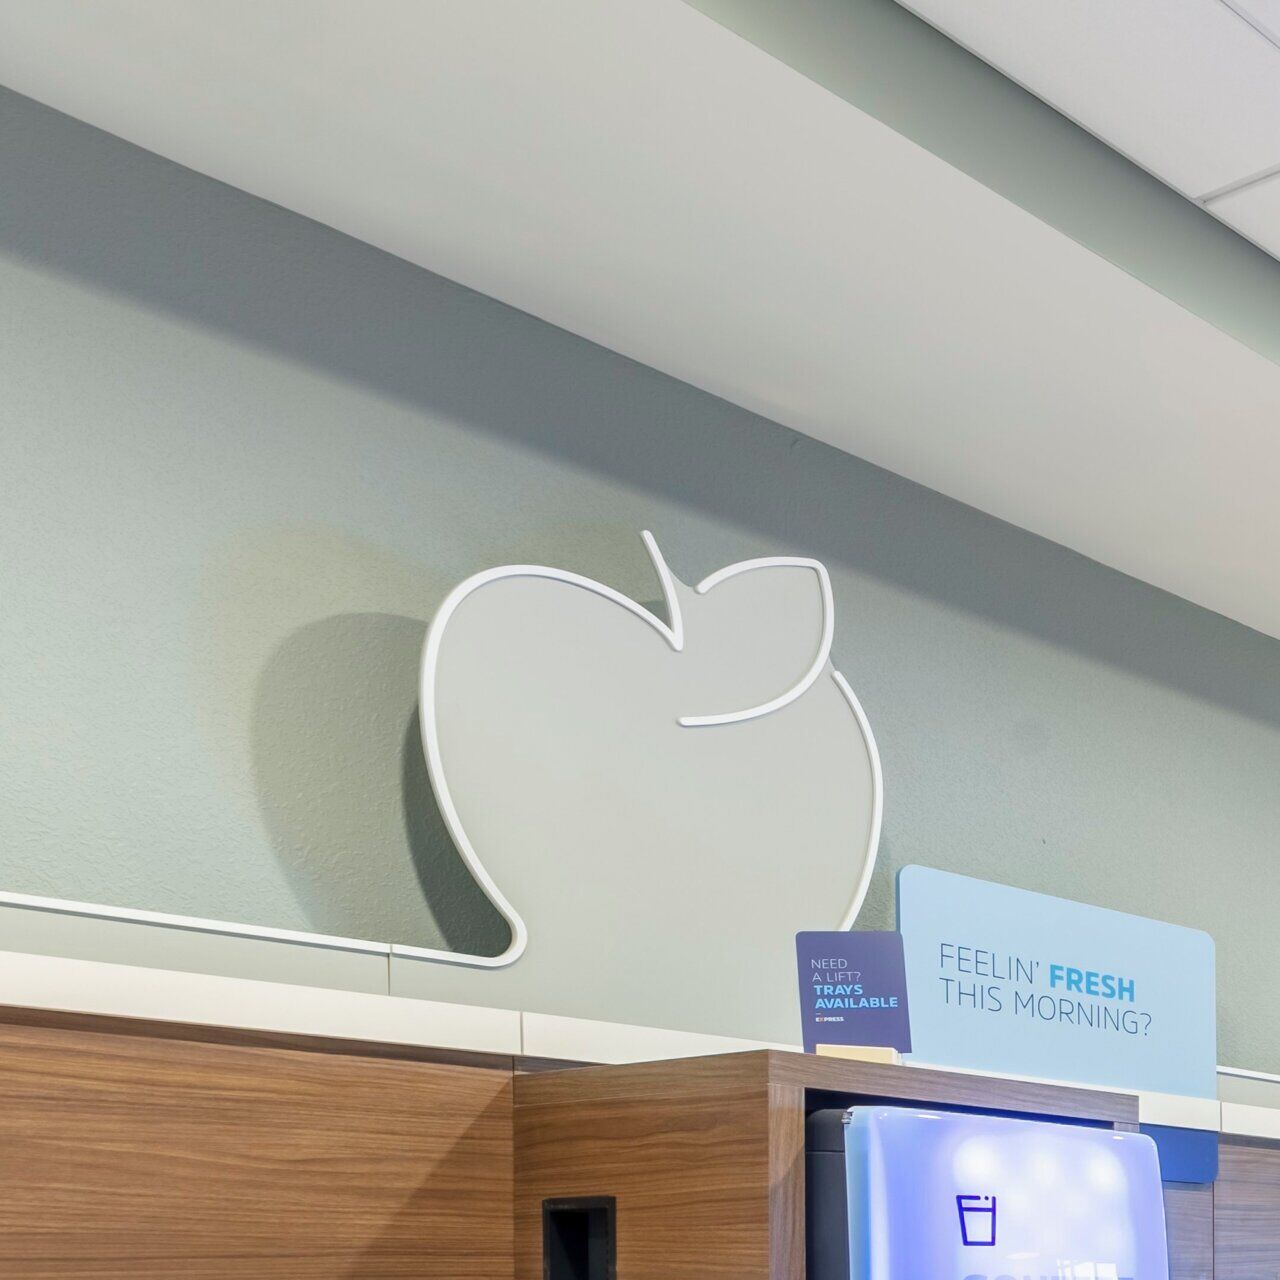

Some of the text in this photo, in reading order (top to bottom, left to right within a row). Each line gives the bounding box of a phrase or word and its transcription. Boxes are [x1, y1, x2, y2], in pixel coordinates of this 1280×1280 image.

[811, 958, 848, 969] NEED
[812, 971, 861, 982] A LIFT?
[1050, 963, 1135, 1002] FRESH
[814, 984, 863, 995] TRAYS
[815, 997, 898, 1009] AVAILABLE
[939, 977, 1152, 1036] THIS MORNING?
